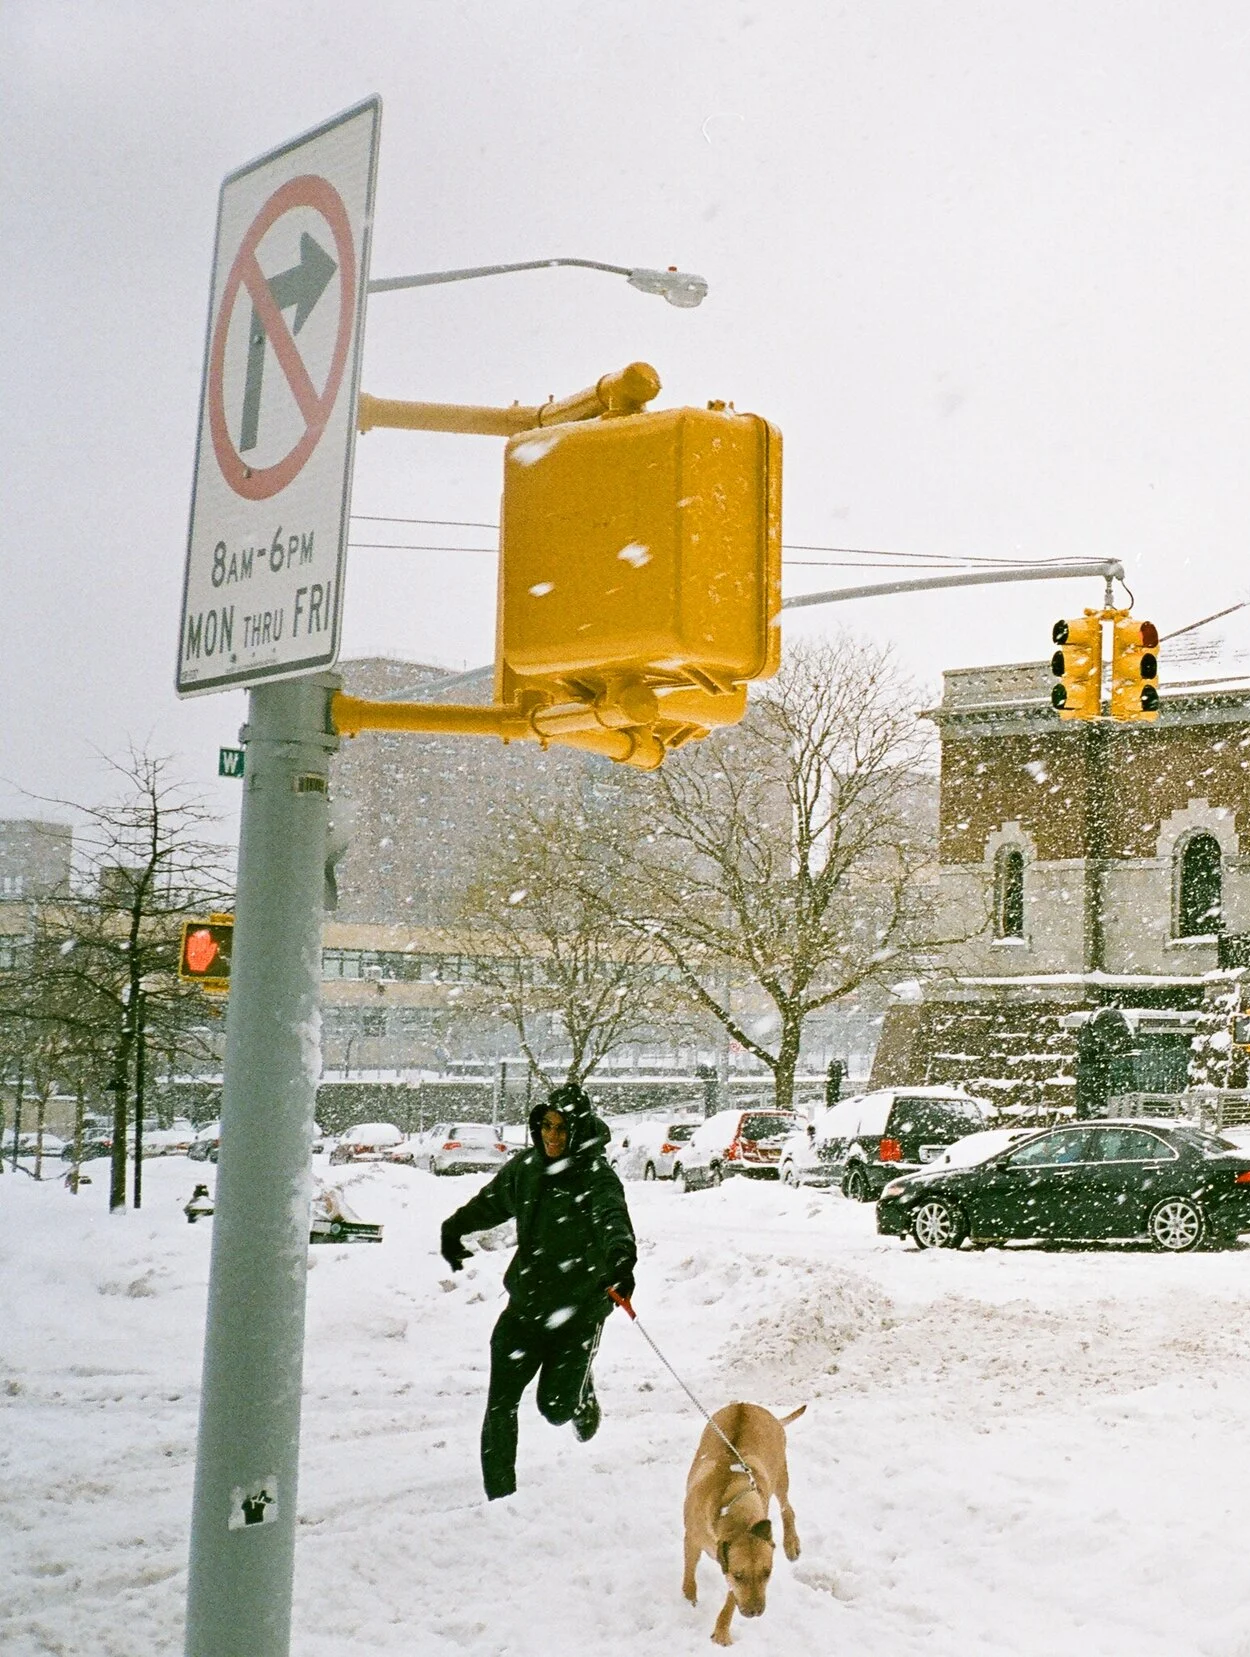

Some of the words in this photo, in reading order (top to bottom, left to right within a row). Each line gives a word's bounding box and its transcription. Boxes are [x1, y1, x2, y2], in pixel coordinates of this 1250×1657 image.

[211, 525, 314, 588] 8AM-6PM
[186, 605, 235, 661] MON
[243, 608, 284, 648] THRU
[292, 580, 332, 638] FRI
[223, 751, 239, 774] W
